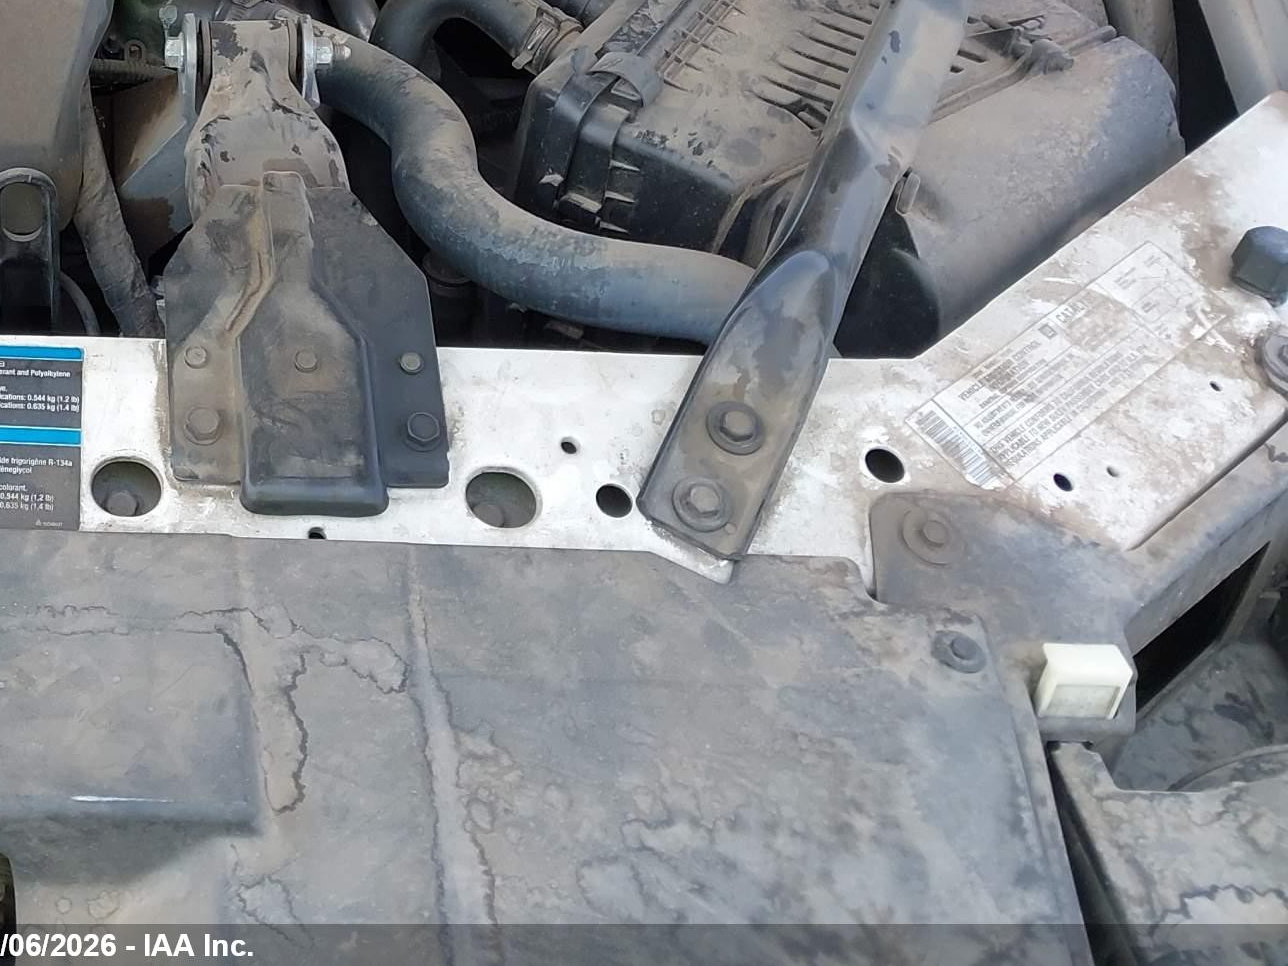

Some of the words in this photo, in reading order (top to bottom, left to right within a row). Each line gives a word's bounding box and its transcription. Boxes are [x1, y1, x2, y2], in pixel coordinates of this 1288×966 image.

[47, 394, 55, 402] kg
[46, 403, 55, 411] kg
[20, 492, 29, 501] kg
[20, 501, 28, 510] kg
